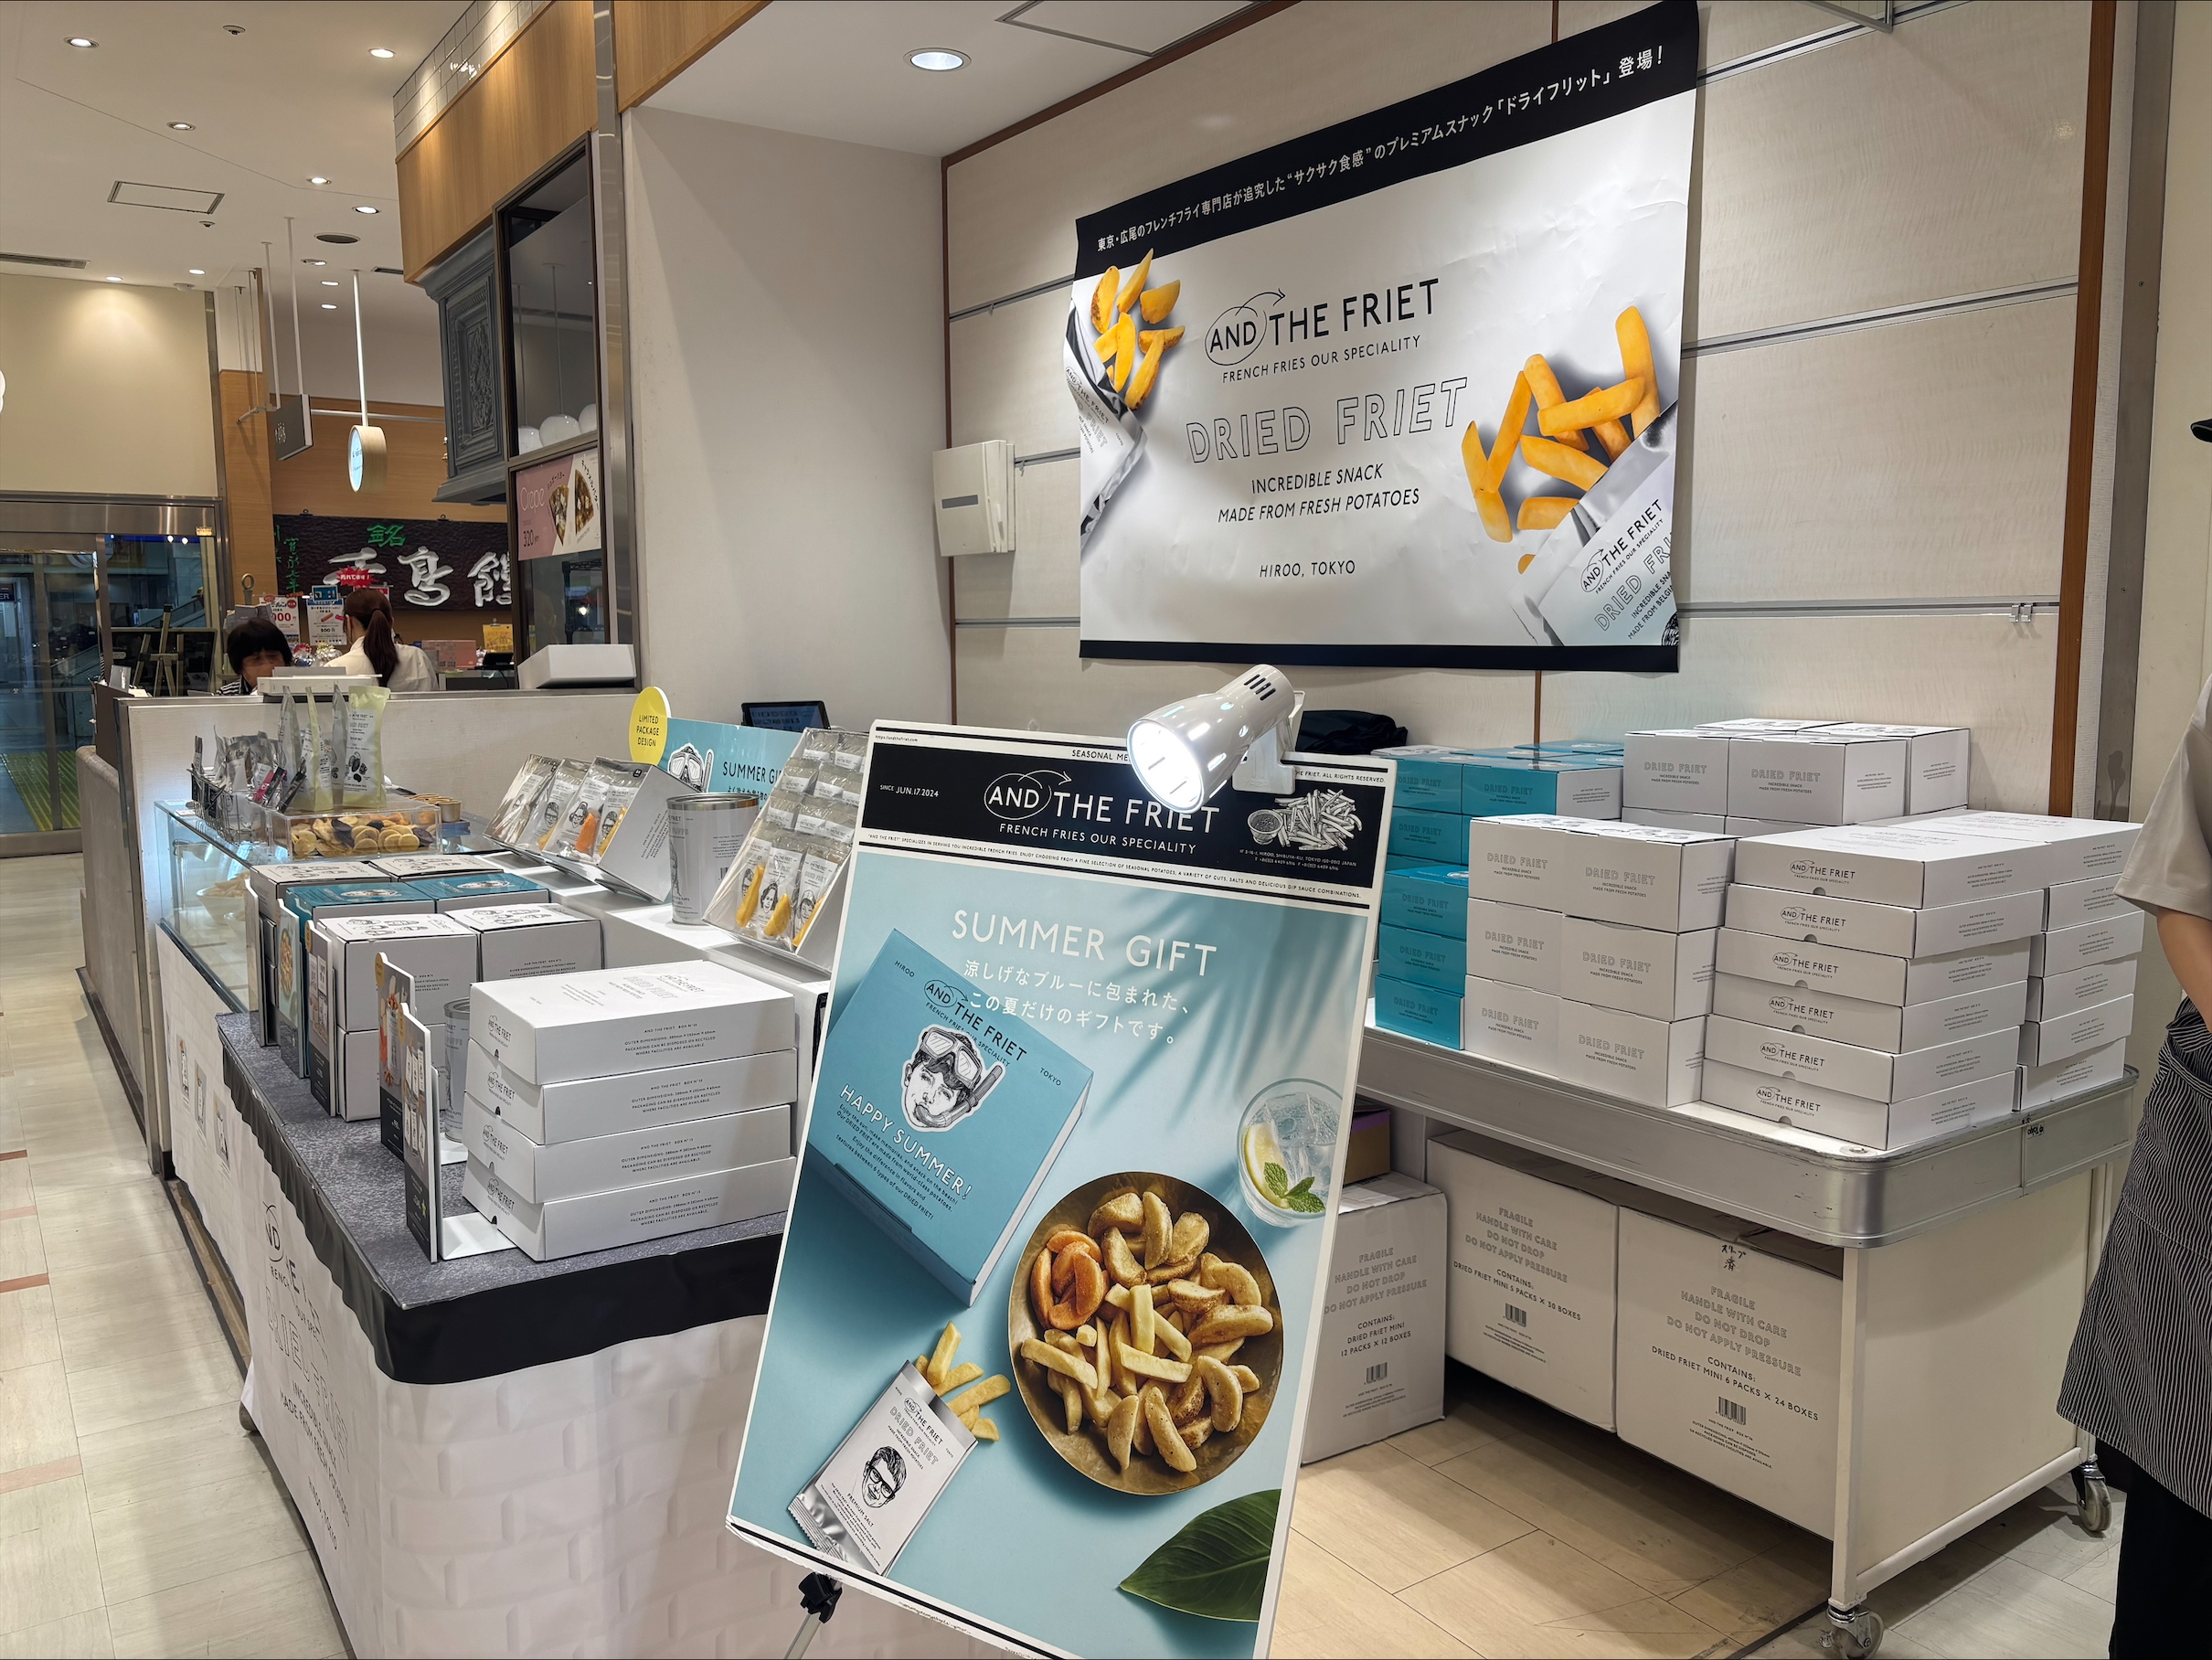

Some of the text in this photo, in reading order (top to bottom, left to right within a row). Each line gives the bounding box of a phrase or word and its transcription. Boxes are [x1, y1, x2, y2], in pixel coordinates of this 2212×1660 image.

[1209, 279, 1439, 353] AND THE FRIET
[1223, 335, 1420, 383] FRENCH FRIES OUR SPECIALITY
[1186, 377, 1467, 463] DRIED FRIET
[1251, 463, 1383, 494] INCREDIBLE SNACK
[1218, 488, 1420, 523] MADE FROM FRESH POTATOES
[1583, 499, 1663, 590] AND THE FRIET
[1595, 518, 1664, 594] FRENCH FRIES OUR SPECIALITY
[1260, 560, 1356, 578] HIROO, TOKYO
[1594, 575, 1642, 632] DRIED
[1632, 582, 1662, 619] INCREDIBLE
[1628, 621, 1644, 639] MADE
[1643, 604, 1658, 623] FROM
[636, 725, 659, 737] PACKAGE
[639, 715, 658, 724] LIMITED
[638, 738, 656, 747] DESIGN
[1072, 750, 1112, 760] SEASONAL
[723, 761, 766, 782] SUMMER
[1644, 761, 1707, 775] DRIED FRIET
[988, 785, 1219, 834] AND THE FRIET
[999, 823, 1196, 855] FRENCH FRIES OUR SPECIALITY
[962, 844, 985, 852] INCREDIBLE
[1035, 852, 1059, 860] CHOOSING
[1091, 859, 1116, 867] SELECTION
[1125, 864, 1150, 872] SEASONAL
[1183, 871, 1203, 879] VARIETY
[1259, 880, 1286, 889] DELICIOUS
[1298, 885, 1316, 893] SAUCE
[1318, 888, 1361, 899] COMBINATIONS.
[1585, 867, 1656, 886] DRIED FRIET
[1810, 867, 1826, 876] THE
[1830, 869, 1856, 878] FRIET
[952, 910, 1217, 976] SUMMER GIFT
[895, 960, 915, 978] HIROO
[963, 960, 1188, 1014] 涼しげなブルーに包まれた、
[502, 1027, 512, 1042] FRIET
[926, 983, 1026, 1061] AND THE FRIET
[970, 991, 1174, 1044] この夏だけのギフトです。
[1039, 1067, 1061, 1086] TOKYO
[840, 1084, 973, 1200] HAPPY SUMMER!
[1454, 1261, 1473, 1274] DRIED
[1474, 1270, 1492, 1282] FRIET
[1494, 1278, 1508, 1290] MINI
[1516, 1288, 1537, 1302] PACKS
[1547, 1301, 1556, 1310] 30
[1558, 1305, 1581, 1321] BOXES
[1710, 1285, 1756, 1311] FRAGILE
[1357, 1314, 1395, 1330] CONTAINS:
[1681, 1291, 1787, 1339] HANDLE WITH CARE
[1695, 1311, 1771, 1347] DO NOT DROP
[1347, 1322, 1405, 1344] DRIED FRIET MINI
[1350, 1343, 1371, 1354] PACKS
[1390, 1331, 1411, 1343] BOXES
[1667, 1315, 1802, 1378] DO NOT APPLY PRESSURE
[1652, 1346, 1675, 1361] DRIED
[1678, 1357, 1701, 1372] FRIET
[1703, 1367, 1722, 1381] MINI
[1725, 1376, 1730, 1384] 6
[1732, 1379, 1760, 1397] PACKS
[1774, 1397, 1785, 1407] 24
[1788, 1402, 1819, 1421] BOXES
[1707, 1357, 1756, 1383] CONTAINS:
[889, 1406, 939, 1465] DRIED FRIET
[905, 1399, 943, 1445] AND THE FRIET
[847, 1493, 874, 1527] PREMIUM SALT
